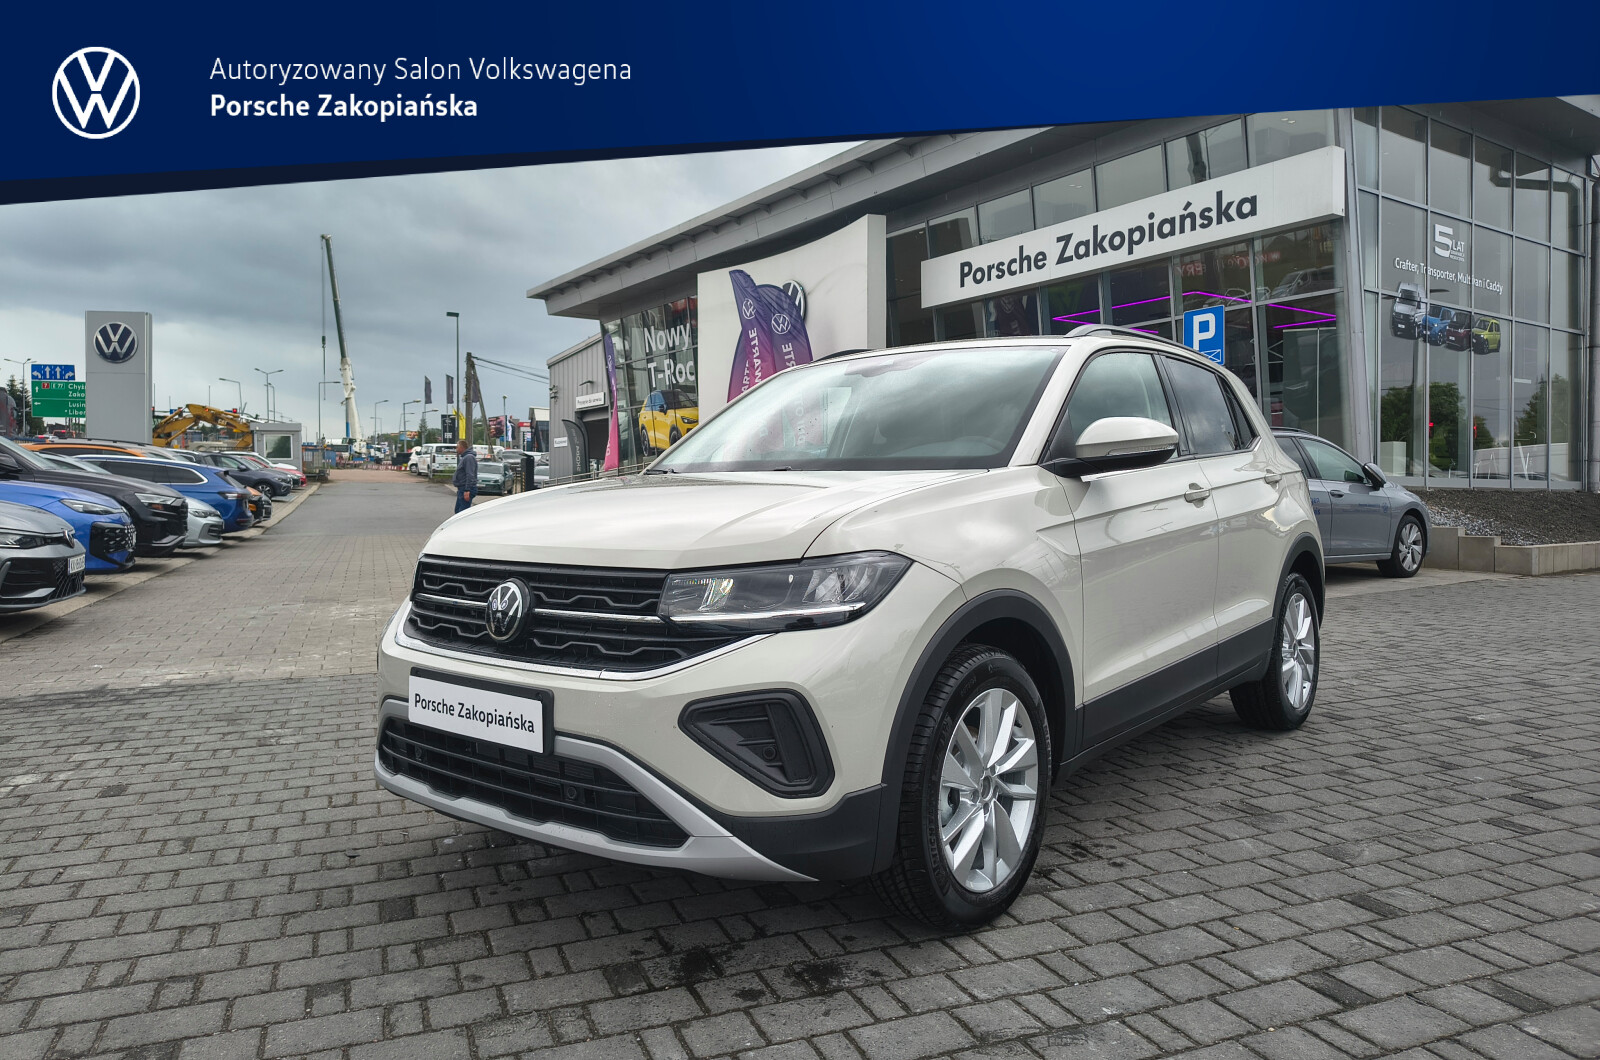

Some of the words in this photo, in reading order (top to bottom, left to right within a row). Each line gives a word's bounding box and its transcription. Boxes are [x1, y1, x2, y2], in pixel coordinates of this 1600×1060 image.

[960, 245, 1047, 288] Porsche
[1056, 190, 1258, 266] Zakopiańska
[1435, 224, 1453, 258] 5
[1453, 240, 1465, 253] LAT
[1395, 257, 1419, 275] Crafter,
[1486, 279, 1504, 295] Caddy
[643, 322, 690, 353] Nowy
[1193, 312, 1216, 351] P
[68, 383, 86, 391] Chyż
[647, 358, 696, 388] T-Roc
[414, 693, 455, 717] Porsche
[457, 702, 535, 734] Zakopiańska
